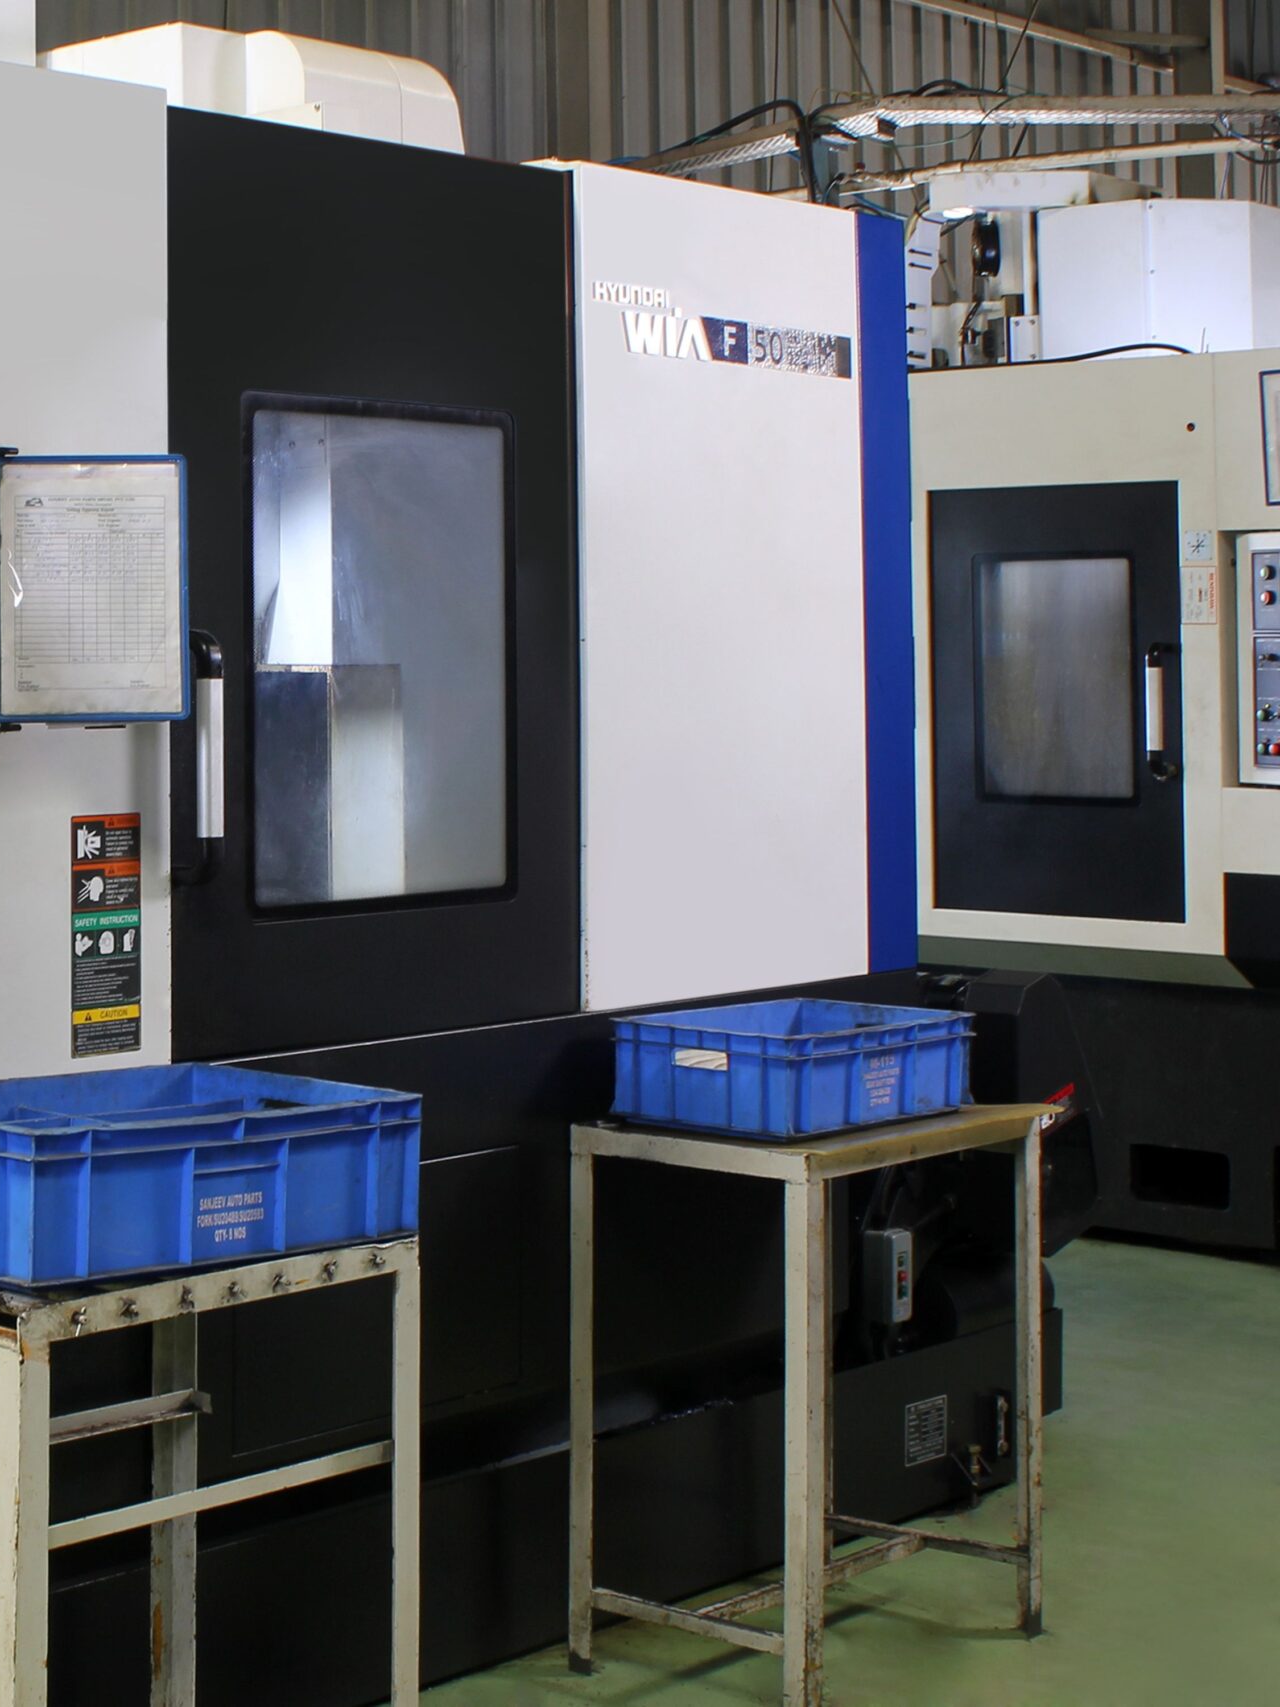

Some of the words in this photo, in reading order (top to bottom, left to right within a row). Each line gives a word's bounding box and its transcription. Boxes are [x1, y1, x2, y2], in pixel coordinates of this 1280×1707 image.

[723, 326, 737, 358] F
[74, 917, 98, 928] SAFETY
[99, 914, 139, 926] INSTRUCTION
[100, 1008, 128, 1019] CAUTION
[200, 1196, 226, 1211] SANJEEV
[227, 1194, 243, 1207] AUTO
[244, 1192, 263, 1205] PARTS
